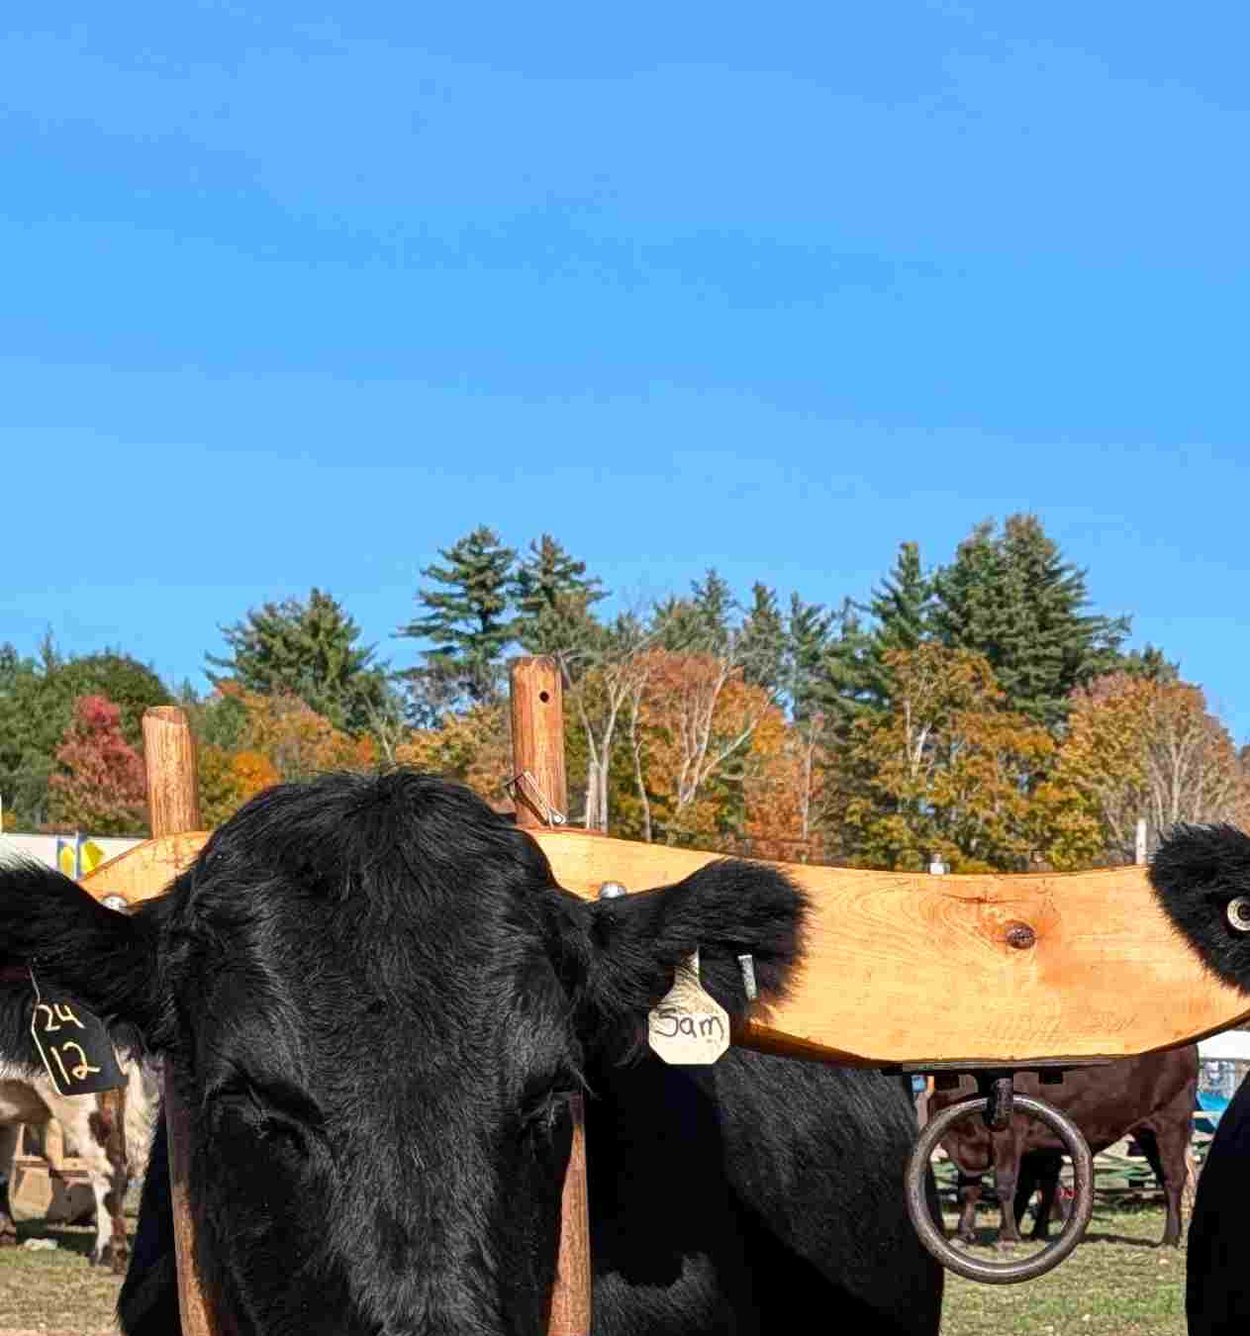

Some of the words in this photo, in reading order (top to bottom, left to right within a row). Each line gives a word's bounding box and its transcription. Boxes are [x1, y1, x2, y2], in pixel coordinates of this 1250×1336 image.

[37, 1003, 86, 1031] 24
[655, 1008, 724, 1041] Sam
[50, 1041, 100, 1085] 12
